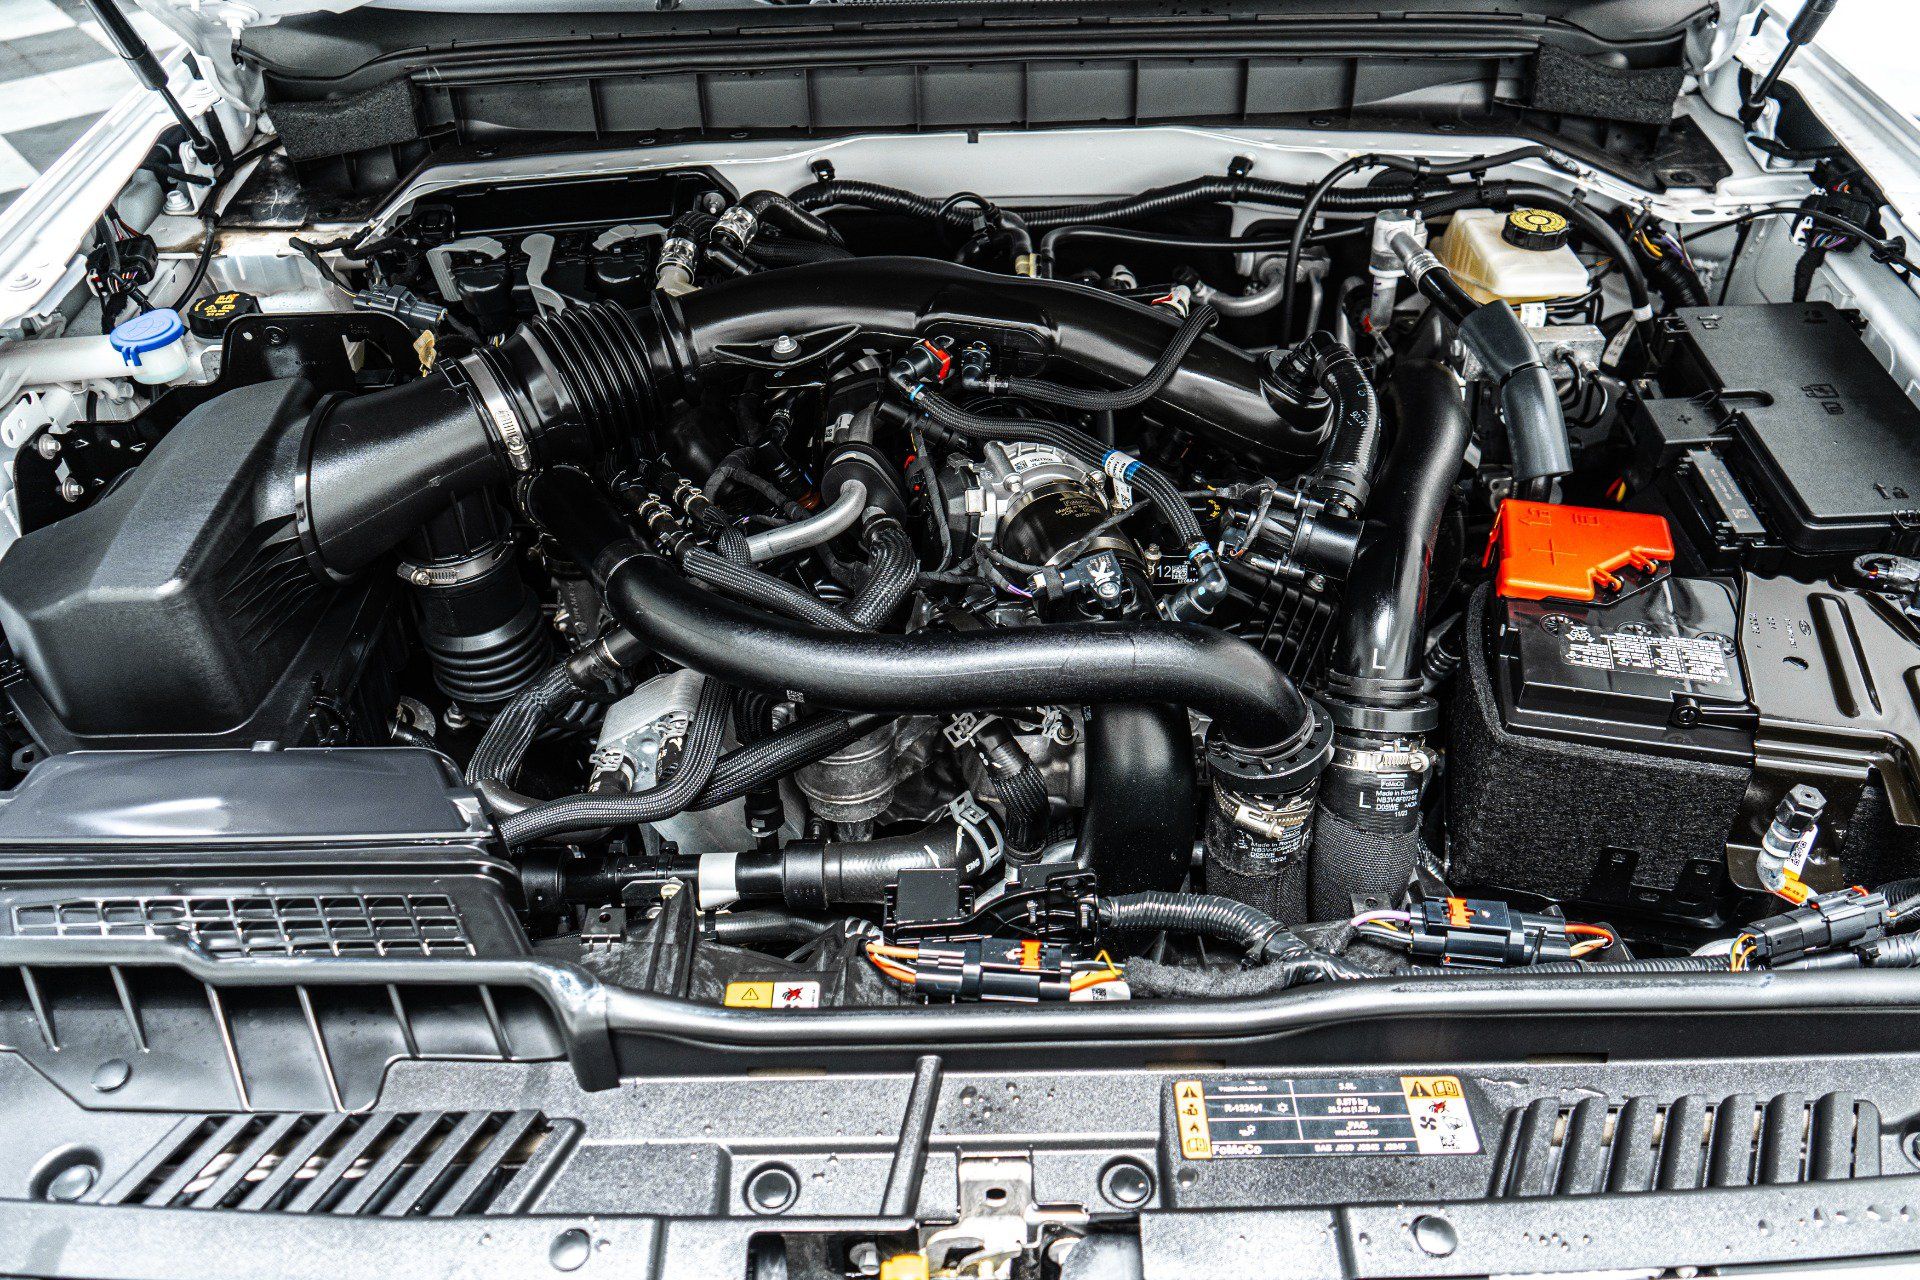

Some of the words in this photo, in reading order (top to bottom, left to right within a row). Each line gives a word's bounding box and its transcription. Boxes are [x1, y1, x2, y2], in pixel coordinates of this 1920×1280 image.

[1157, 565, 1172, 578] 12
[1372, 648, 1386, 669] L
[1359, 792, 1371, 808] L
[1212, 1144, 1263, 1155] FoMoCo
